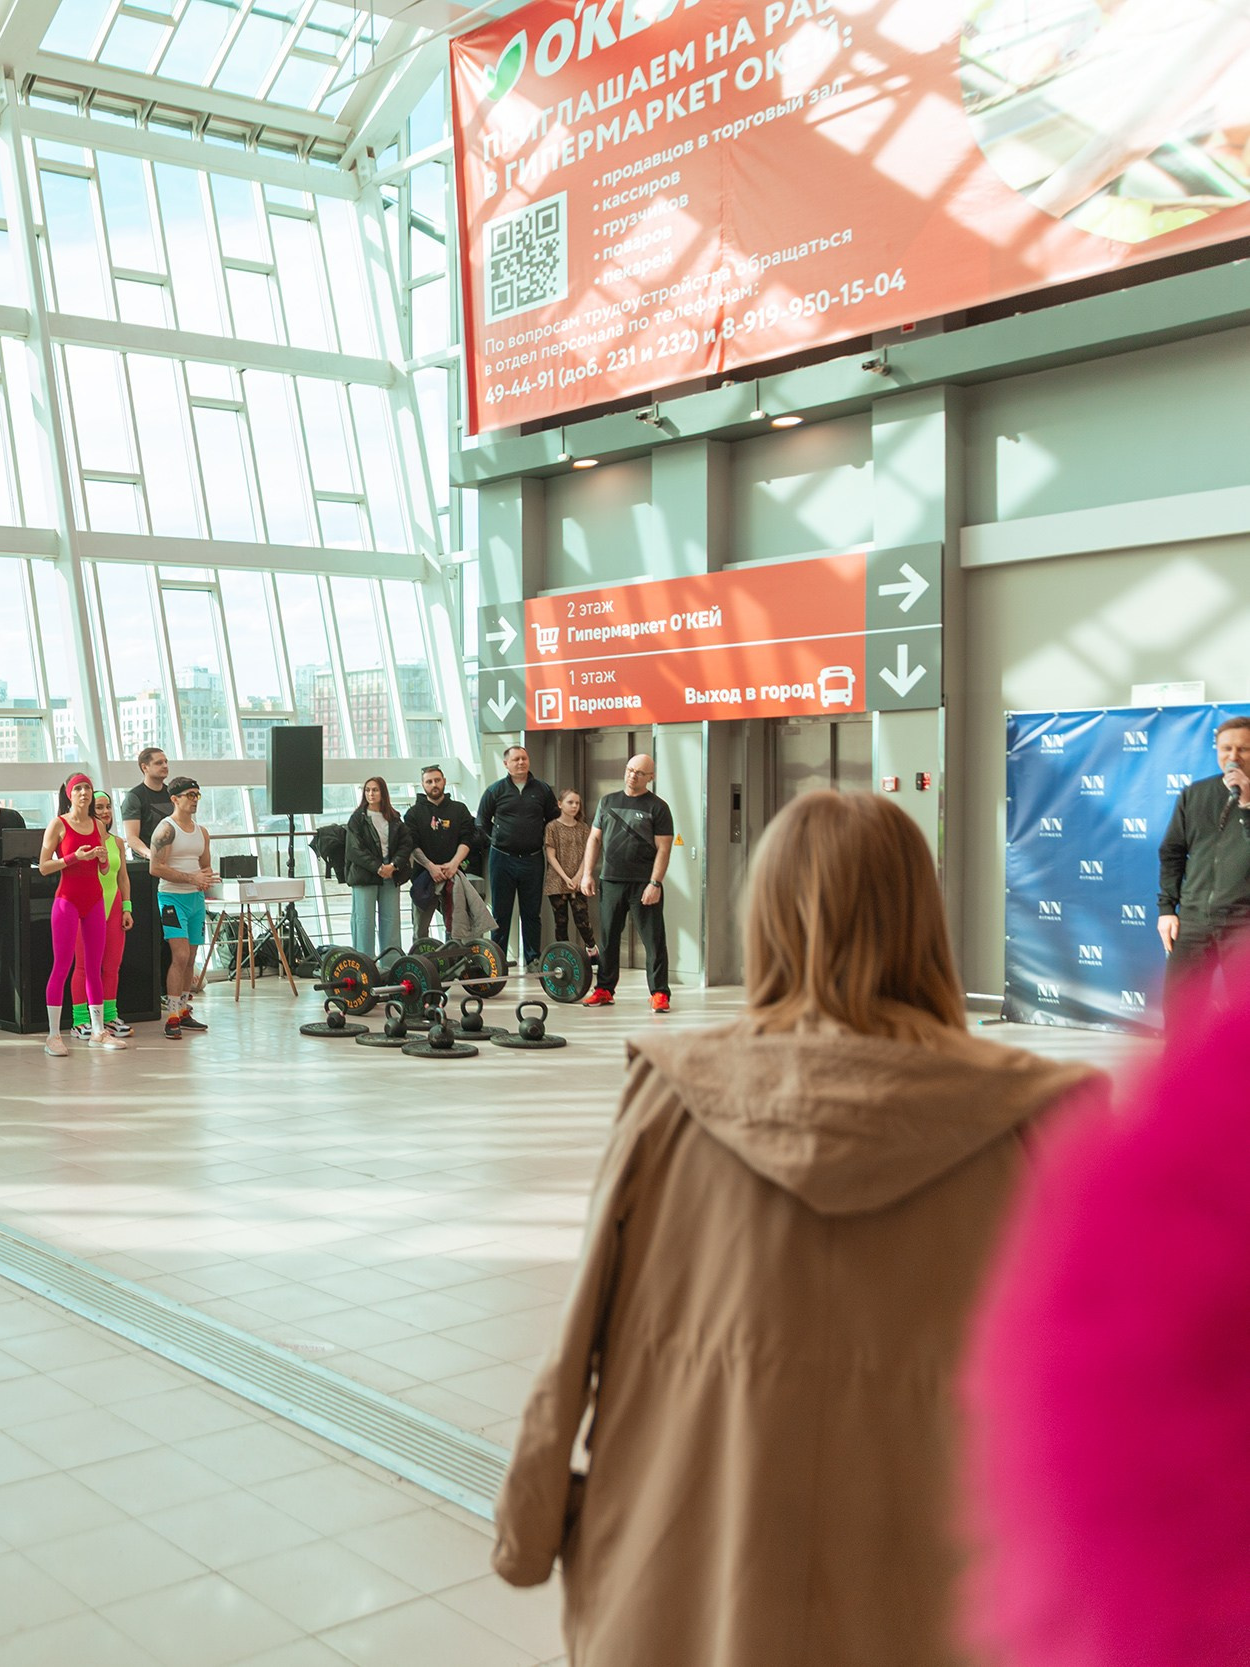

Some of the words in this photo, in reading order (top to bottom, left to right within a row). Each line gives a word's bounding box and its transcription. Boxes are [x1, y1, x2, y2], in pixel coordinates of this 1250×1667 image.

[705, 16, 756, 64] НА
[483, 171, 498, 200] В
[505, 69, 728, 191] ГИПЕРМАРКЕТ
[734, 15, 852, 91] ОКЙ:
[602, 139, 694, 187] продавцов
[698, 135, 708, 149] в
[712, 93, 804, 139] торговый
[808, 79, 843, 104] зал
[602, 171, 681, 212] кассиров
[602, 194, 689, 237] грузчиков
[603, 225, 672, 260] поваров
[603, 247, 672, 285] пекарей
[485, 338, 504, 355] По
[508, 316, 579, 349] вопросам
[584, 267, 731, 325] трудоустройства
[735, 228, 852, 276] обращаться
[485, 364, 492, 376] в
[496, 350, 537, 374] отдел
[541, 323, 623, 358] персонала
[629, 316, 649, 333] по
[654, 283, 759, 323] телефонам:
[485, 368, 554, 404] 49-44-91
[558, 358, 603, 388] (доб.
[607, 346, 636, 371] 231
[641, 347, 653, 362] и
[657, 329, 698, 357] 232)
[703, 328, 715, 344] и
[722, 268, 906, 339] 8-919-950-15-04
[567, 602, 575, 618] 2
[579, 600, 614, 616] этаж
[567, 620, 667, 643] Гипермаркет
[670, 605, 722, 631] О'КЕЙ
[569, 670, 575, 685] 1
[581, 670, 616, 685] этаж
[684, 687, 742, 704] Выход
[746, 687, 756, 700] в
[760, 683, 815, 703] город
[569, 695, 642, 714] Парковка
[1123, 731, 1148, 746] NN
[1081, 775, 1105, 789] NN
[1039, 817, 1062, 831] NN
[1122, 818, 1147, 832] NN
[1079, 860, 1103, 874] NN
[1038, 900, 1062, 915] NN
[1121, 904, 1146, 919] NN
[1078, 944, 1103, 960] NN
[333, 960, 360, 978] STECTER
